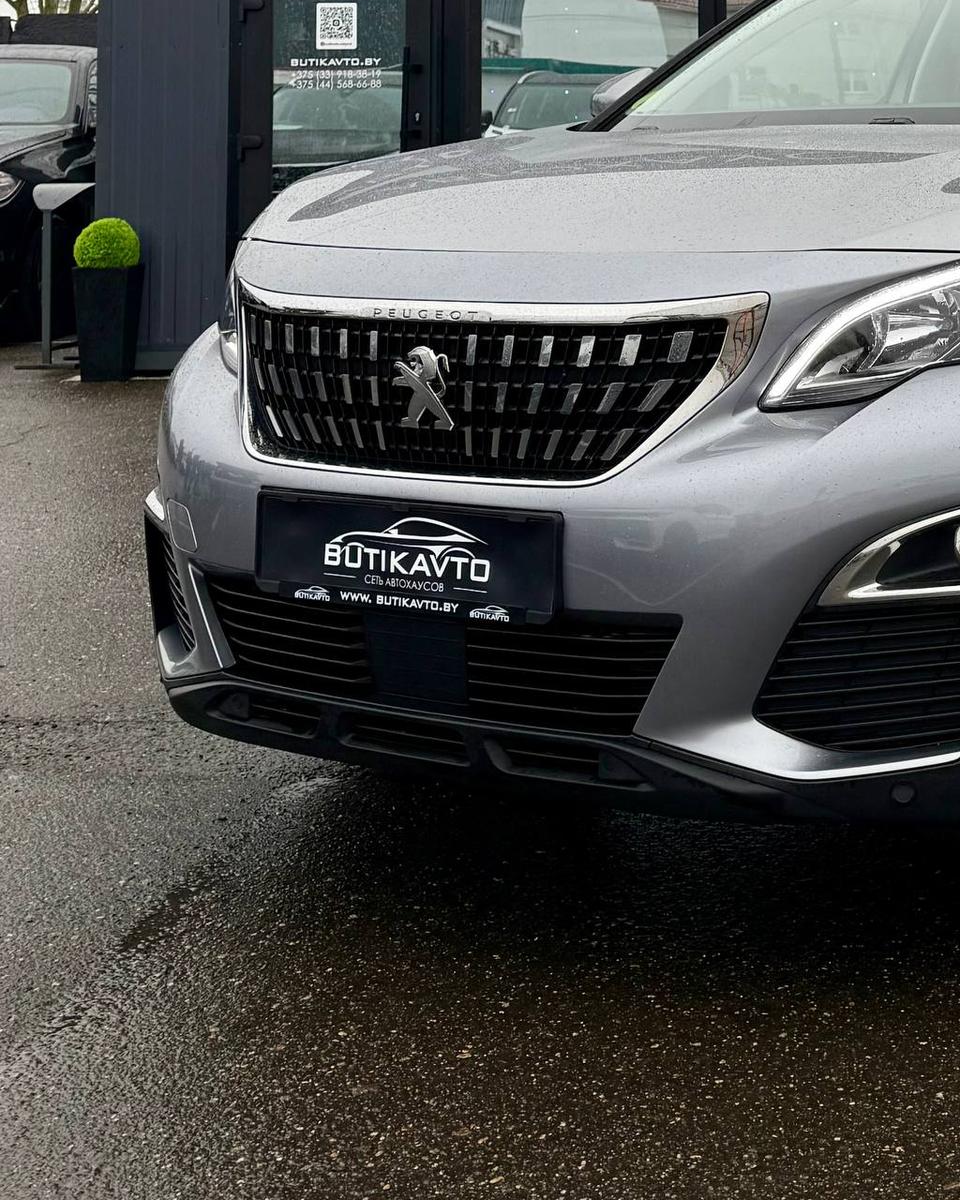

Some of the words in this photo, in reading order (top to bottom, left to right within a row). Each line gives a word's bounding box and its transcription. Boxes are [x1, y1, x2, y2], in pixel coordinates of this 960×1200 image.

[290, 57, 382, 67] BUTIKAVTO.BY
[316, 79, 334, 90] (44)
[373, 307, 479, 320] PEUGEOT
[324, 543, 491, 583] BUTIKAVTO
[364, 574, 384, 586] СЕТЬ
[384, 578, 444, 592] АВТОХАУСОВ
[340, 591, 372, 604] WWW.
[376, 595, 459, 613] BUTIKAVTO.BY
[469, 610, 510, 622] BUTIKAVTO
